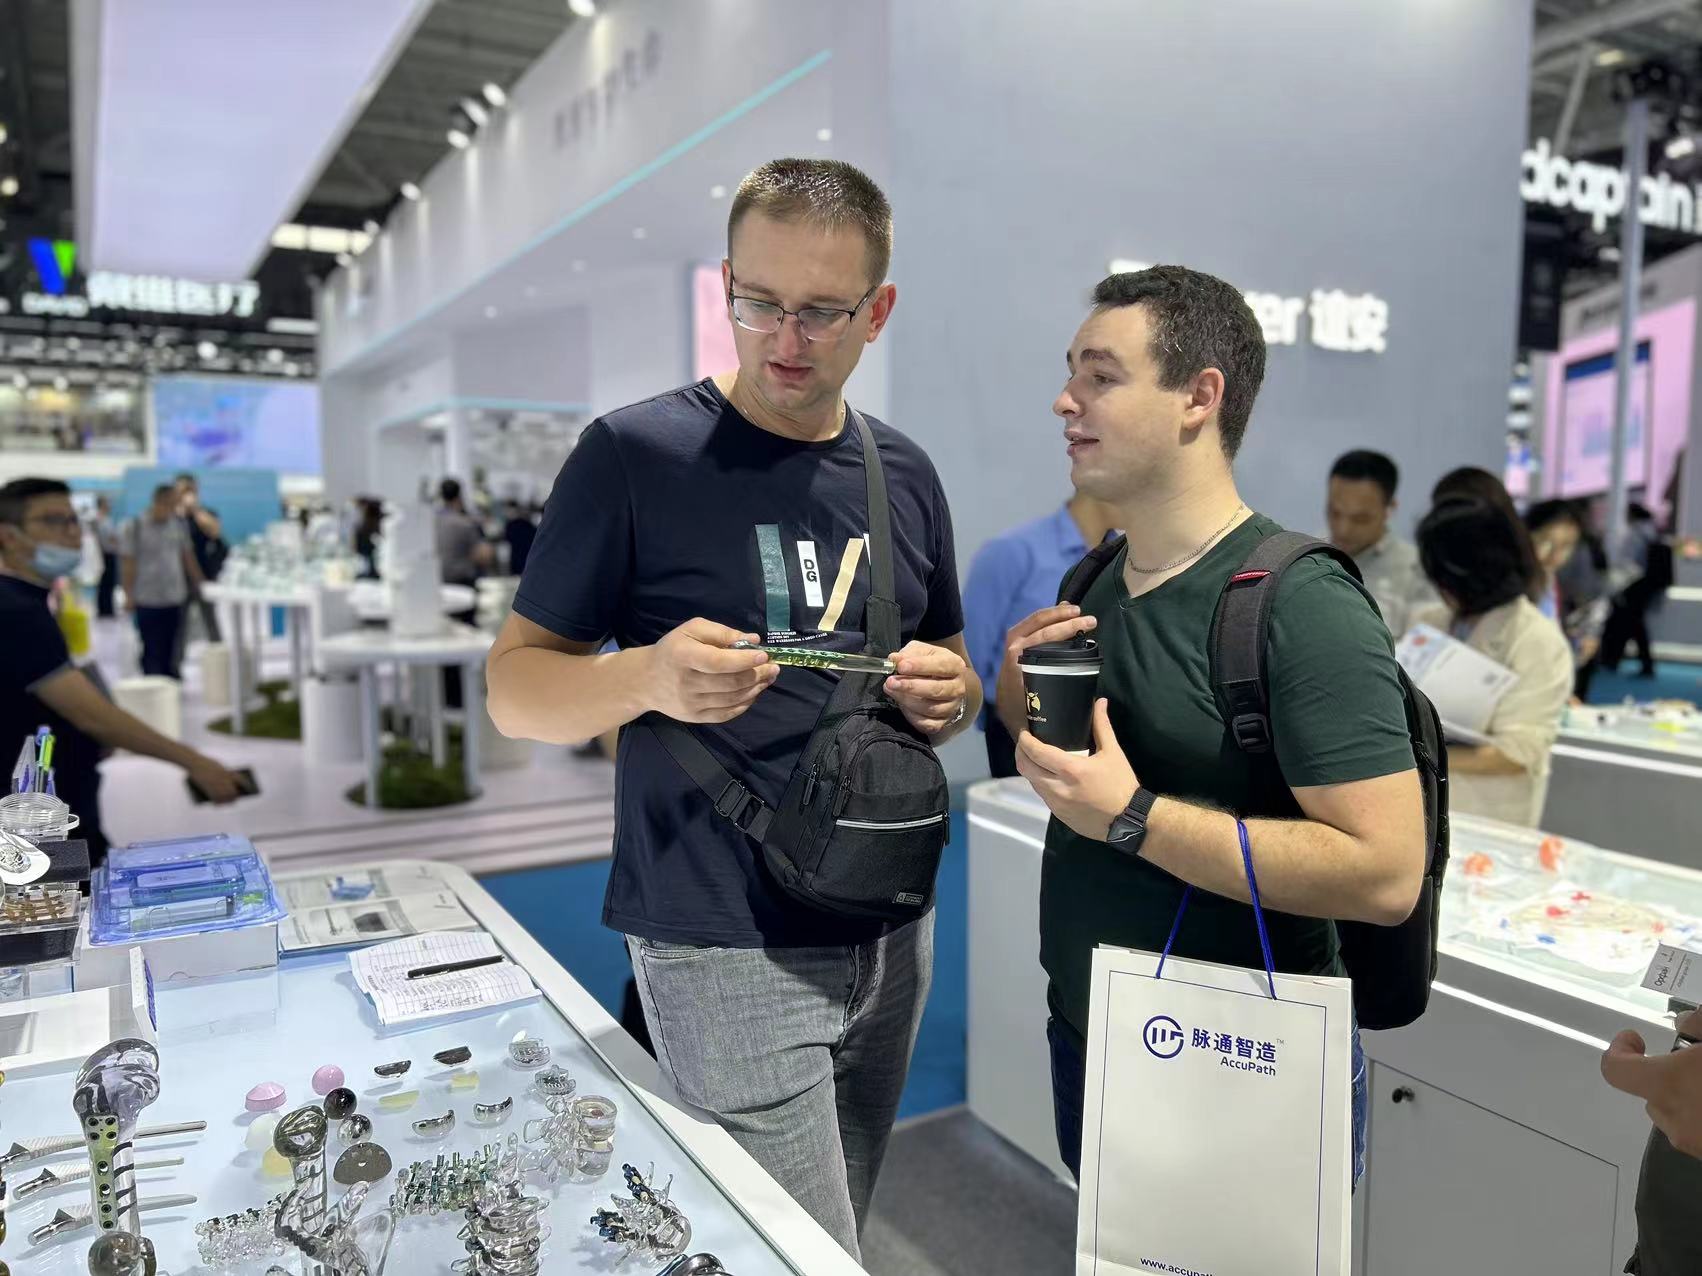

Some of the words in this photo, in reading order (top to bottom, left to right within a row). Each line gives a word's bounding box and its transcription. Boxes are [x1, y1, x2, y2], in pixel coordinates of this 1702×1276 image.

[1520, 137, 1694, 234] dcapain
[1191, 1028, 1276, 1063] 脉通智造
[1220, 1056, 1276, 1076] AccuPath
[1140, 1257, 1213, 1276] www.accu
